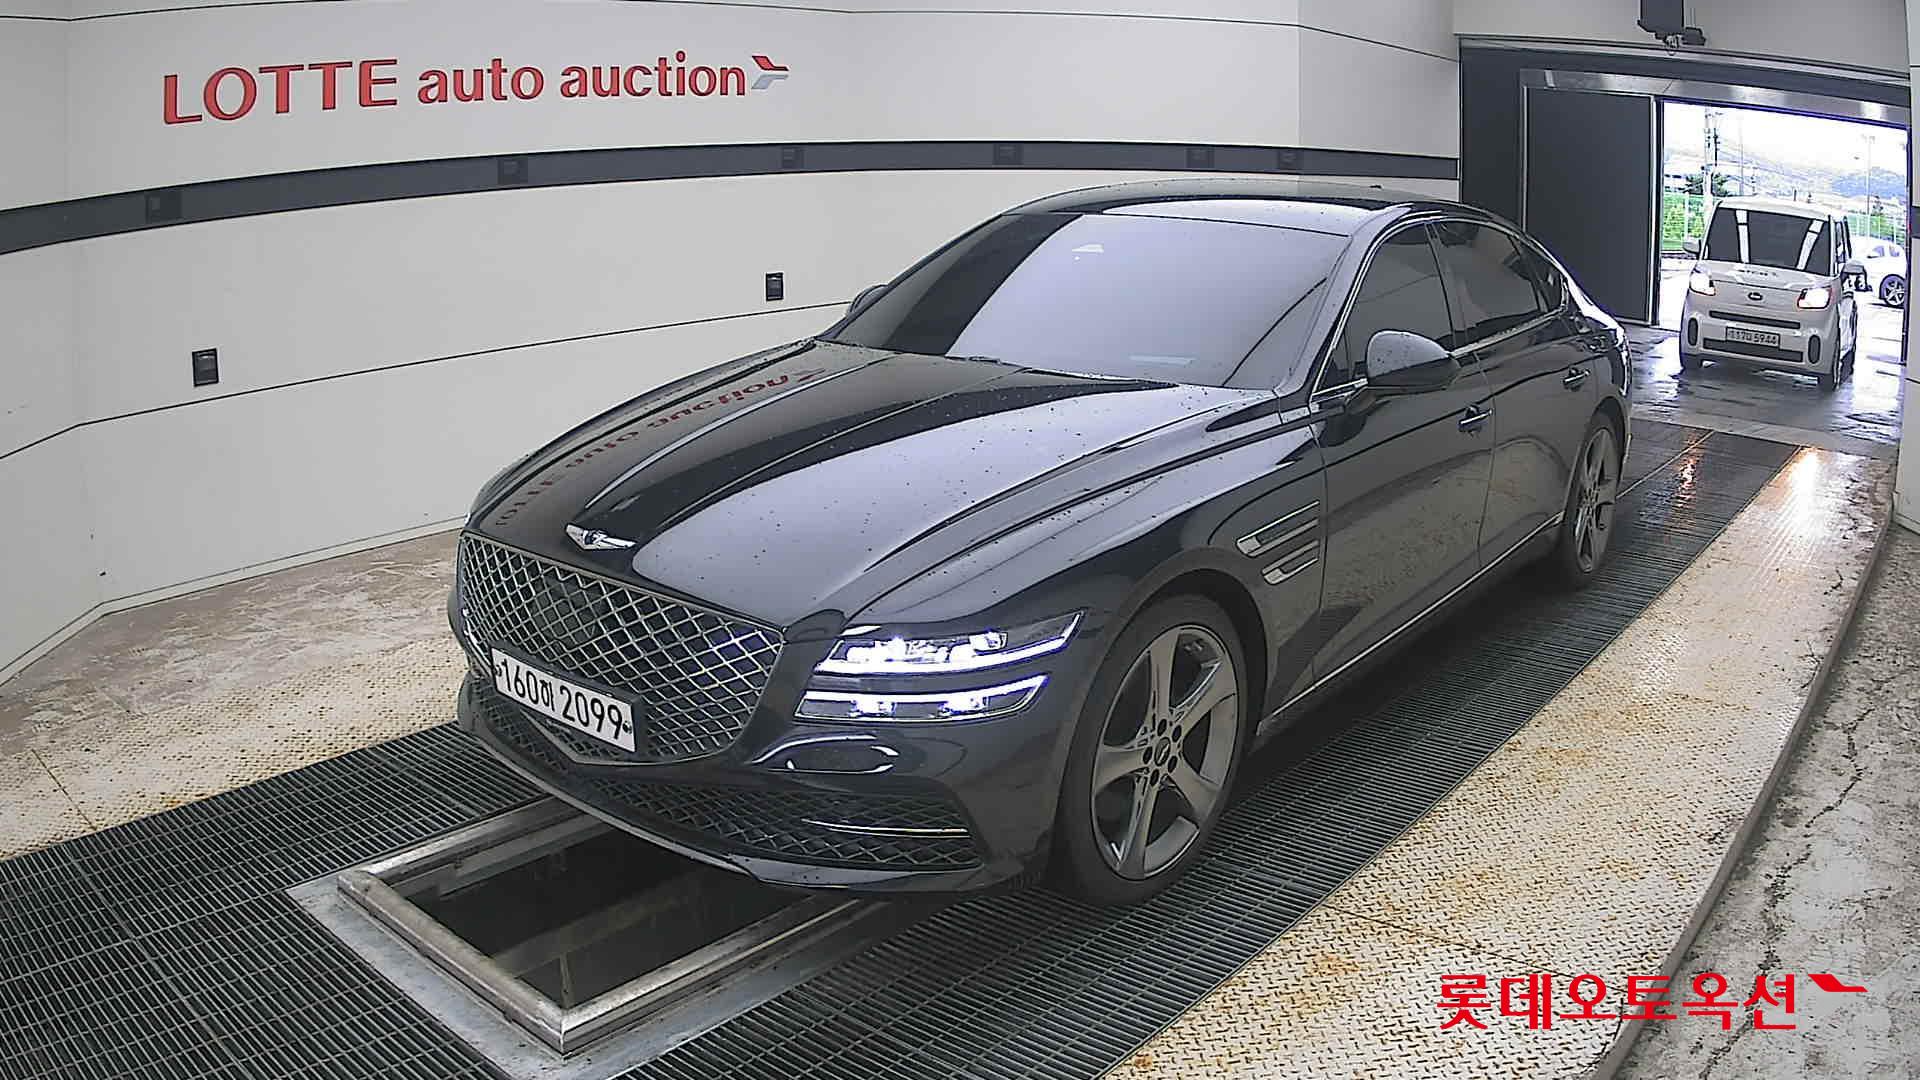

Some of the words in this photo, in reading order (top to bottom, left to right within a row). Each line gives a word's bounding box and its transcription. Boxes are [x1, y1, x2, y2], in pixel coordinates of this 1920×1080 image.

[164, 59, 397, 126] LOTTE
[418, 58, 545, 104] auto
[560, 51, 747, 97] auction
[559, 684, 623, 740] 2099
